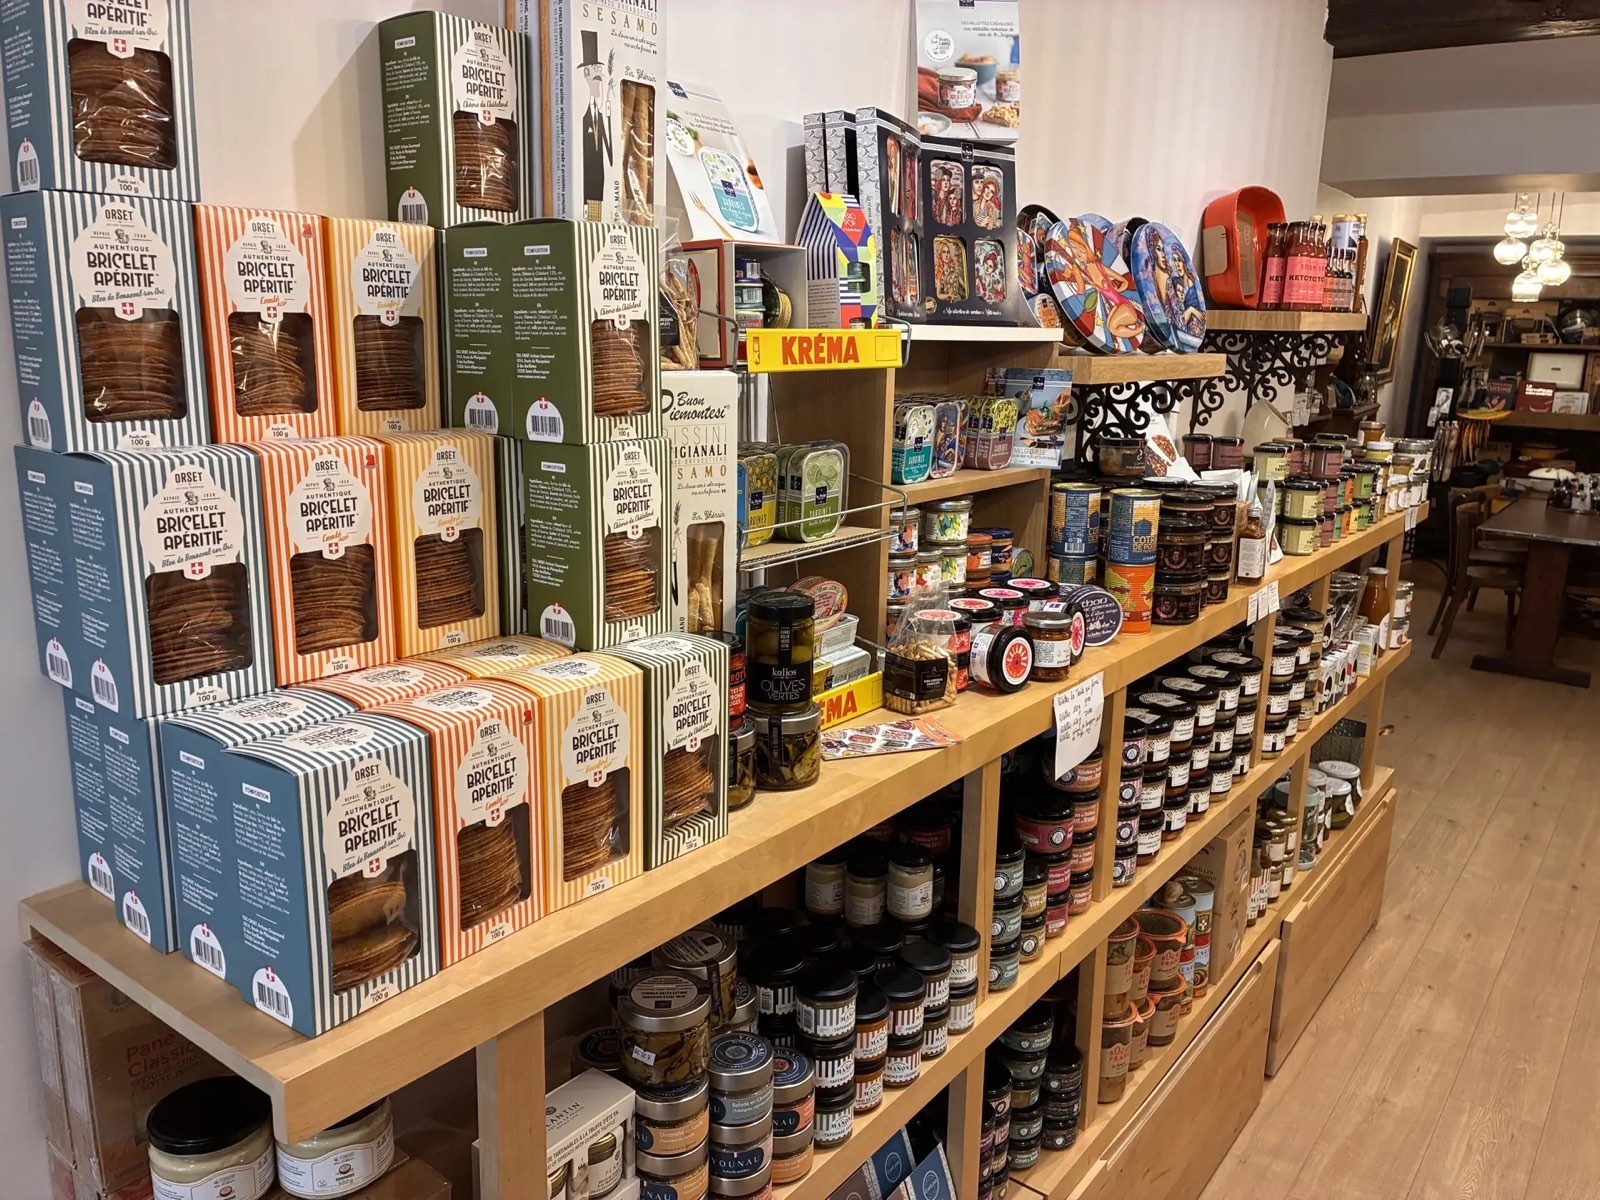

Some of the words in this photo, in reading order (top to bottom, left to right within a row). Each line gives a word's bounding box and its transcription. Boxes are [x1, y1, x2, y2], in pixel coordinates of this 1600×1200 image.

[87, 3, 148, 27] APÉRITIF
[583, 4, 657, 36] SESAMO
[474, 32, 492, 44] ORSET
[466, 58, 502, 70] AUTHENTIQUE
[462, 66, 506, 86] BRICELET
[466, 82, 504, 100] APÉRITIF
[118, 183, 130, 192] 100
[105, 209, 134, 221] ORSET
[252, 222, 276, 234] ORSET
[376, 232, 396, 243] ORSET
[610, 235, 626, 245] ORSET
[94, 244, 149, 252] AUTHENTIQUE
[86, 251, 157, 270] BRICELET
[94, 268, 154, 288] APÉRITIF
[238, 262, 295, 279] BRICELET
[362, 268, 411, 284] BRICELET
[244, 278, 294, 294] APÉRITIF
[600, 272, 639, 288] BRICELET
[367, 284, 409, 299] APÉRITIF
[603, 286, 638, 302] APÉRITIF
[782, 332, 859, 365] KRÉMA
[676, 392, 705, 406] Buon
[131, 438, 144, 446] 100
[664, 426, 728, 443] ISSINI
[436, 452, 456, 461] ORSET
[624, 452, 640, 460] ORSET
[672, 444, 728, 460] IGIANALI
[315, 461, 338, 472] ORSET
[678, 466, 728, 480] SAMO
[174, 472, 202, 485] ORSET
[306, 490, 352, 500] AUTHENTIQUE
[424, 484, 471, 503] BRICELET
[614, 485, 652, 501] BRICELET
[164, 504, 218, 515] AUTHENTIQUE
[300, 497, 358, 518] BRICELET
[428, 500, 469, 517] APÉRITIF
[616, 500, 651, 515] APÉRITIF
[157, 512, 226, 534] BRICELET
[306, 514, 356, 532] APÉRITIF
[164, 530, 224, 550] APÉRITIF
[1082, 598, 1108, 608] thon
[684, 664, 700, 676] ORSET
[772, 666, 797, 676] kalios
[761, 678, 806, 692] OLIVES
[586, 692, 605, 705] ORSET
[677, 690, 708, 702] AUTHENTIQUE
[767, 691, 800, 700] VERTES
[673, 694, 711, 718] BRICELET
[577, 718, 615, 734] AUTHENTIQUE
[676, 710, 710, 732] APÉRITIF
[480, 723, 501, 740] ORSET
[572, 724, 620, 750] BRICELET
[472, 752, 512, 769] AUTHENTIQUE
[576, 742, 617, 766] APÉRITIF
[354, 764, 380, 782] ORSET
[466, 757, 516, 789] BRICELET
[472, 776, 514, 804] APÉRITIF
[344, 794, 394, 816] AUTHENTIQUE
[338, 800, 400, 838] BRICELET
[344, 820, 398, 854] APÉRITIF
[342, 860, 356, 873] Bleu
[592, 882, 602, 892] 100
[492, 930, 501, 940] 100
[372, 994, 382, 1003] 100
[126, 1033, 176, 1062] Pane
[711, 1155, 760, 1168] YOUNAU
